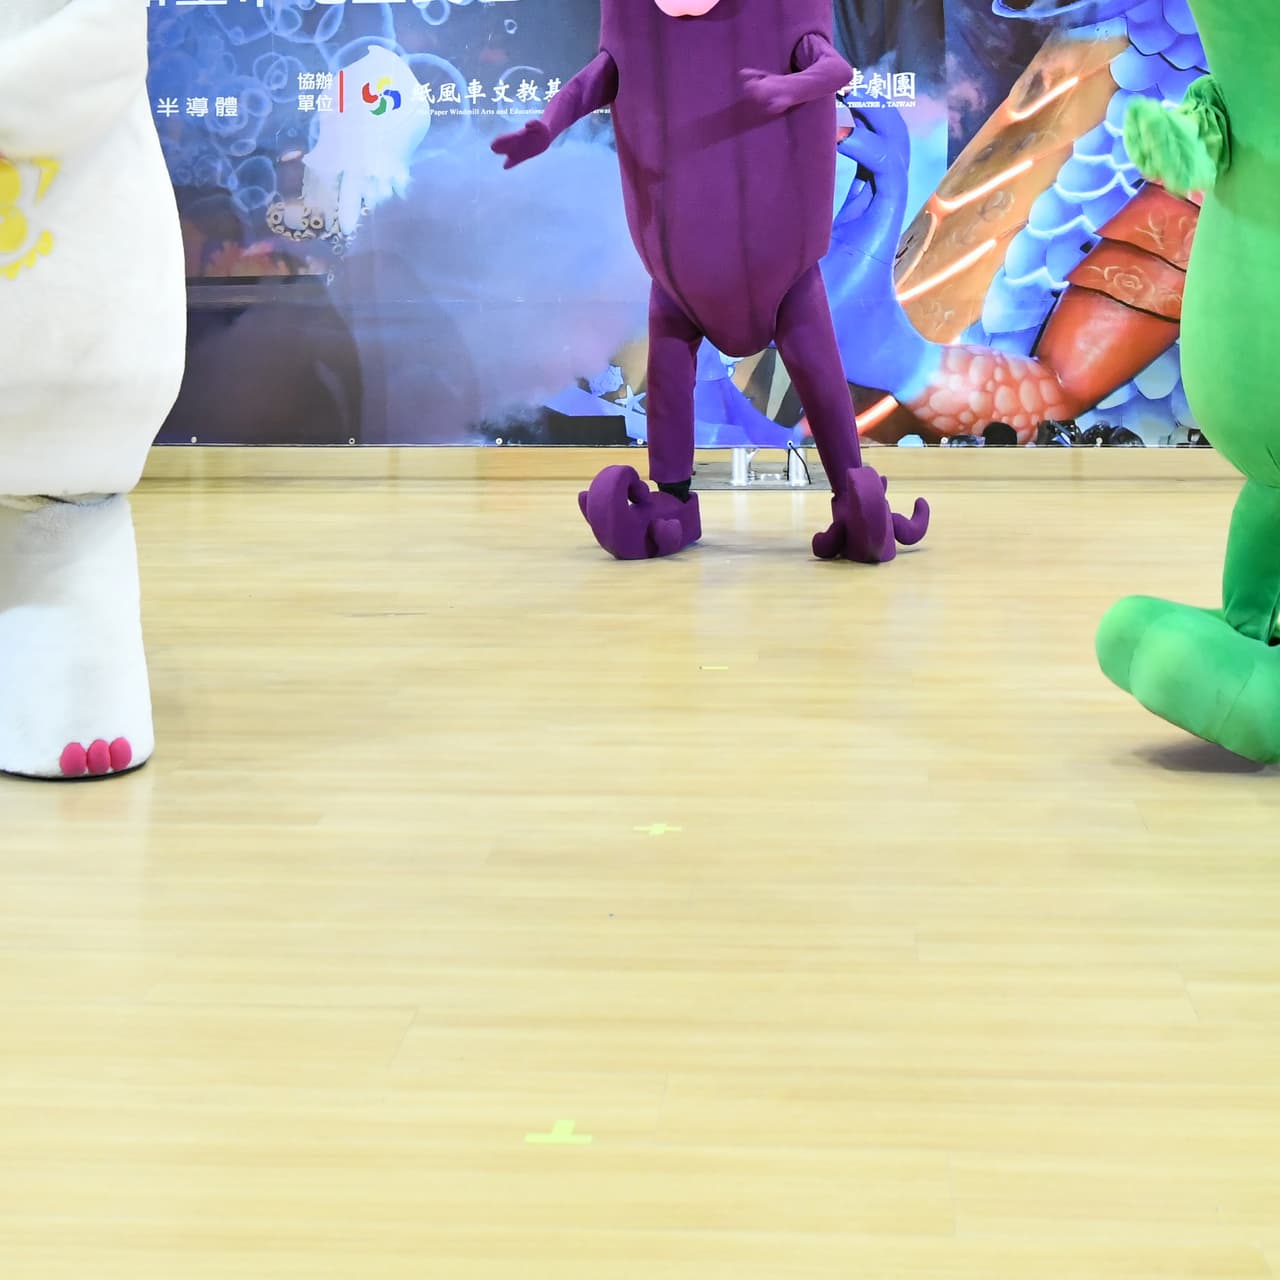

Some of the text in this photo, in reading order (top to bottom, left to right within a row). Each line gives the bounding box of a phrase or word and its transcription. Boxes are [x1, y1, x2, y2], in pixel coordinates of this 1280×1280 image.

[297, 72, 333, 91] 協辦
[156, 96, 239, 118] 半導體
[297, 94, 333, 113] 單位
